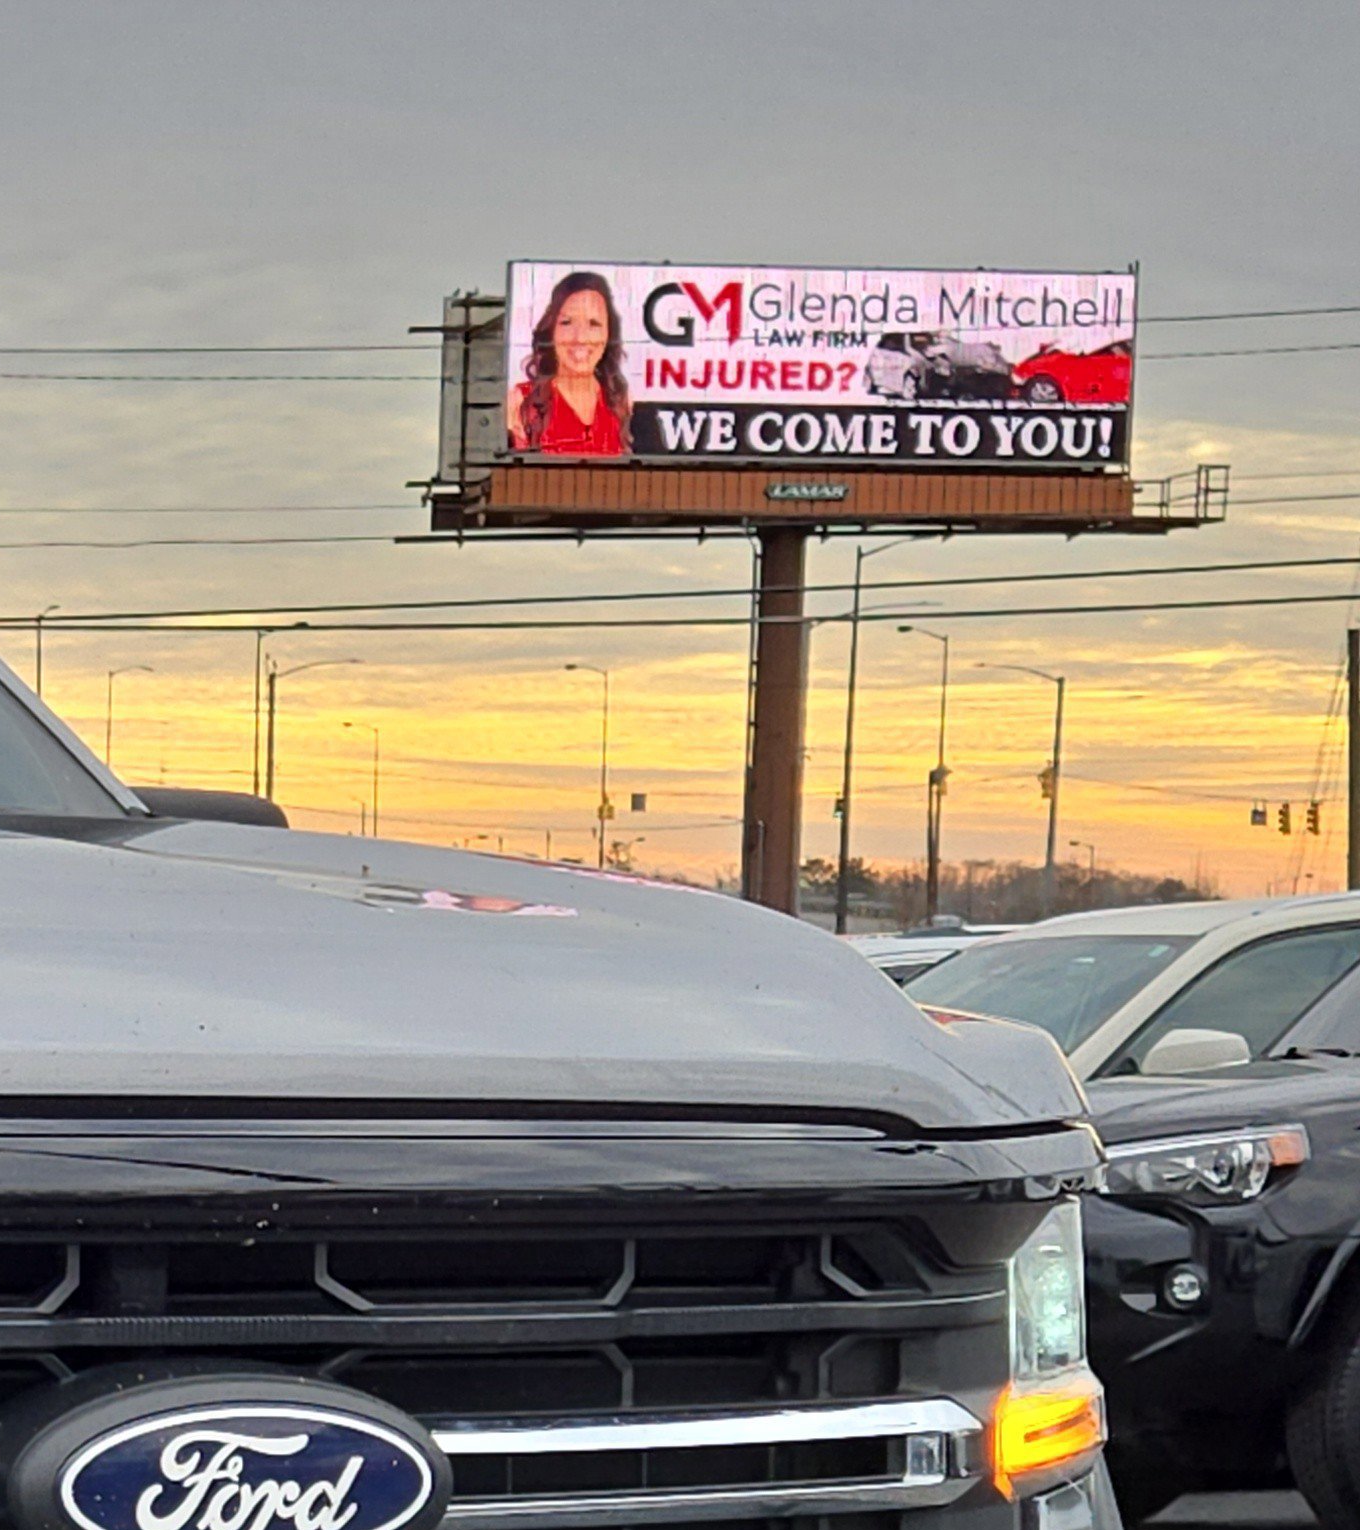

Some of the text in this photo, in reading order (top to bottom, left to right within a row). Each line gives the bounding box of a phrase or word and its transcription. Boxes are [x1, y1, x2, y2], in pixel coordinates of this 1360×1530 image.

[643, 282, 743, 347] GM
[749, 281, 1123, 327] Glenda Mitchell
[753, 328, 869, 349] LAW FIRM
[645, 358, 858, 392] INJURED?
[657, 410, 1114, 458] WE COME TO YOU!
[771, 483, 846, 498] LAMAR
